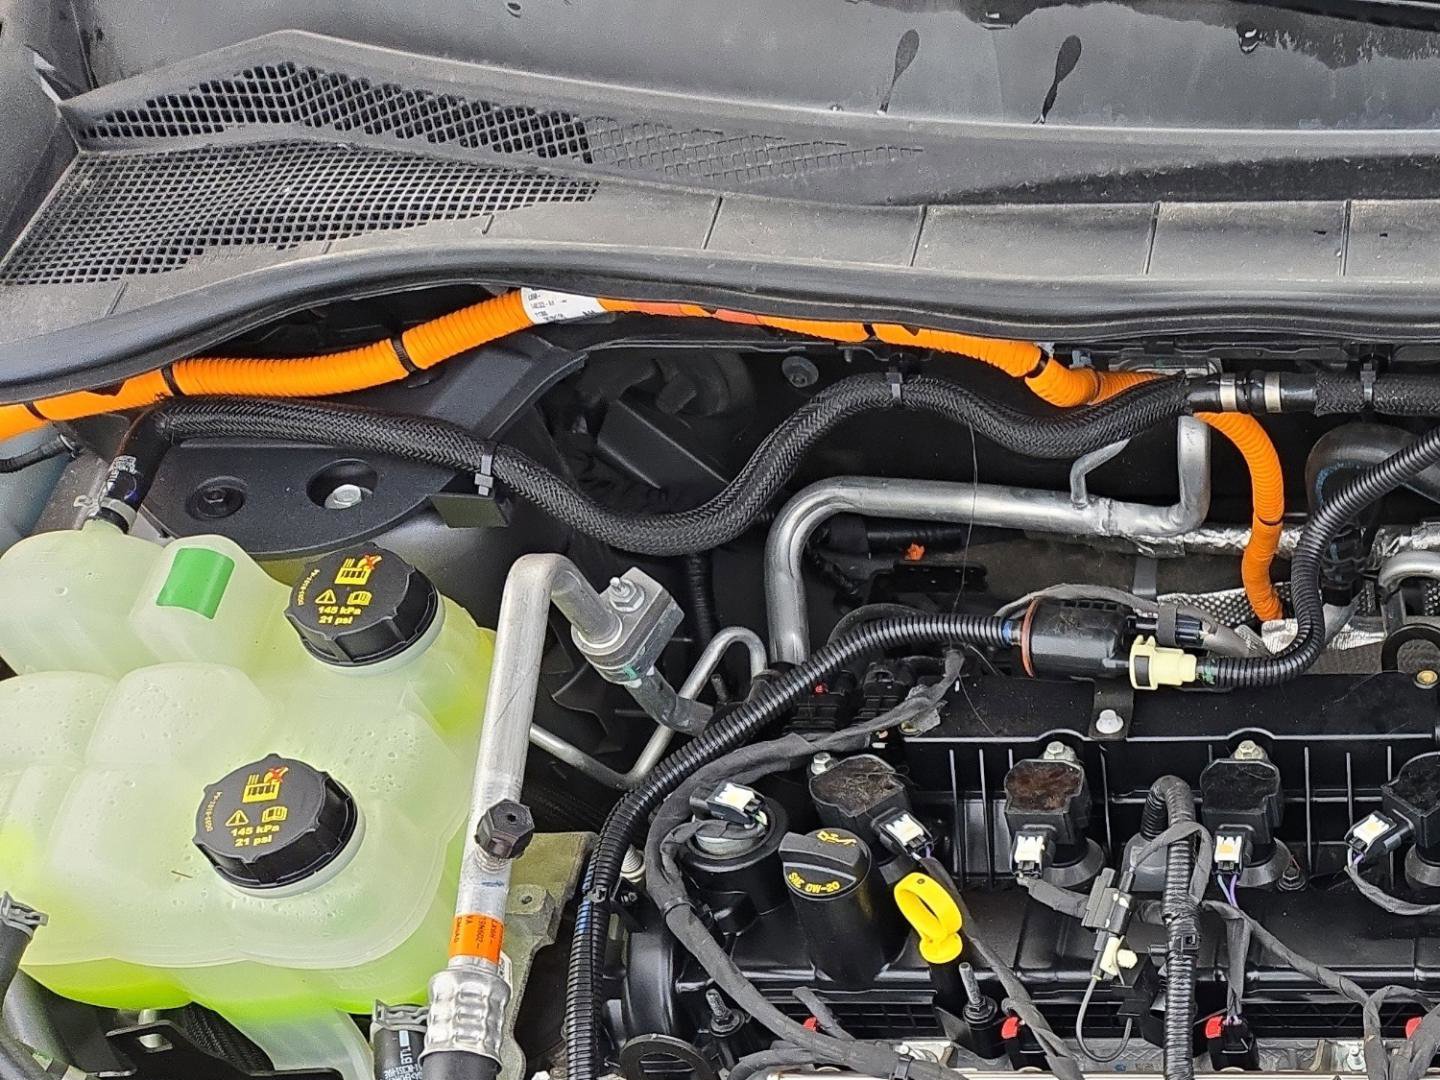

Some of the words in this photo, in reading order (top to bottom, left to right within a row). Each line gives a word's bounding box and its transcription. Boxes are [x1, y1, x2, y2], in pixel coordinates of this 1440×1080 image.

[318, 605, 339, 615] 145
[340, 606, 362, 615] kPa
[318, 615, 332, 624] 21
[334, 616, 353, 625] psi
[230, 826, 253, 837] 145
[256, 824, 280, 834] kPa
[234, 838, 250, 847] 21
[253, 835, 273, 846] psi
[788, 872, 805, 889] SAE
